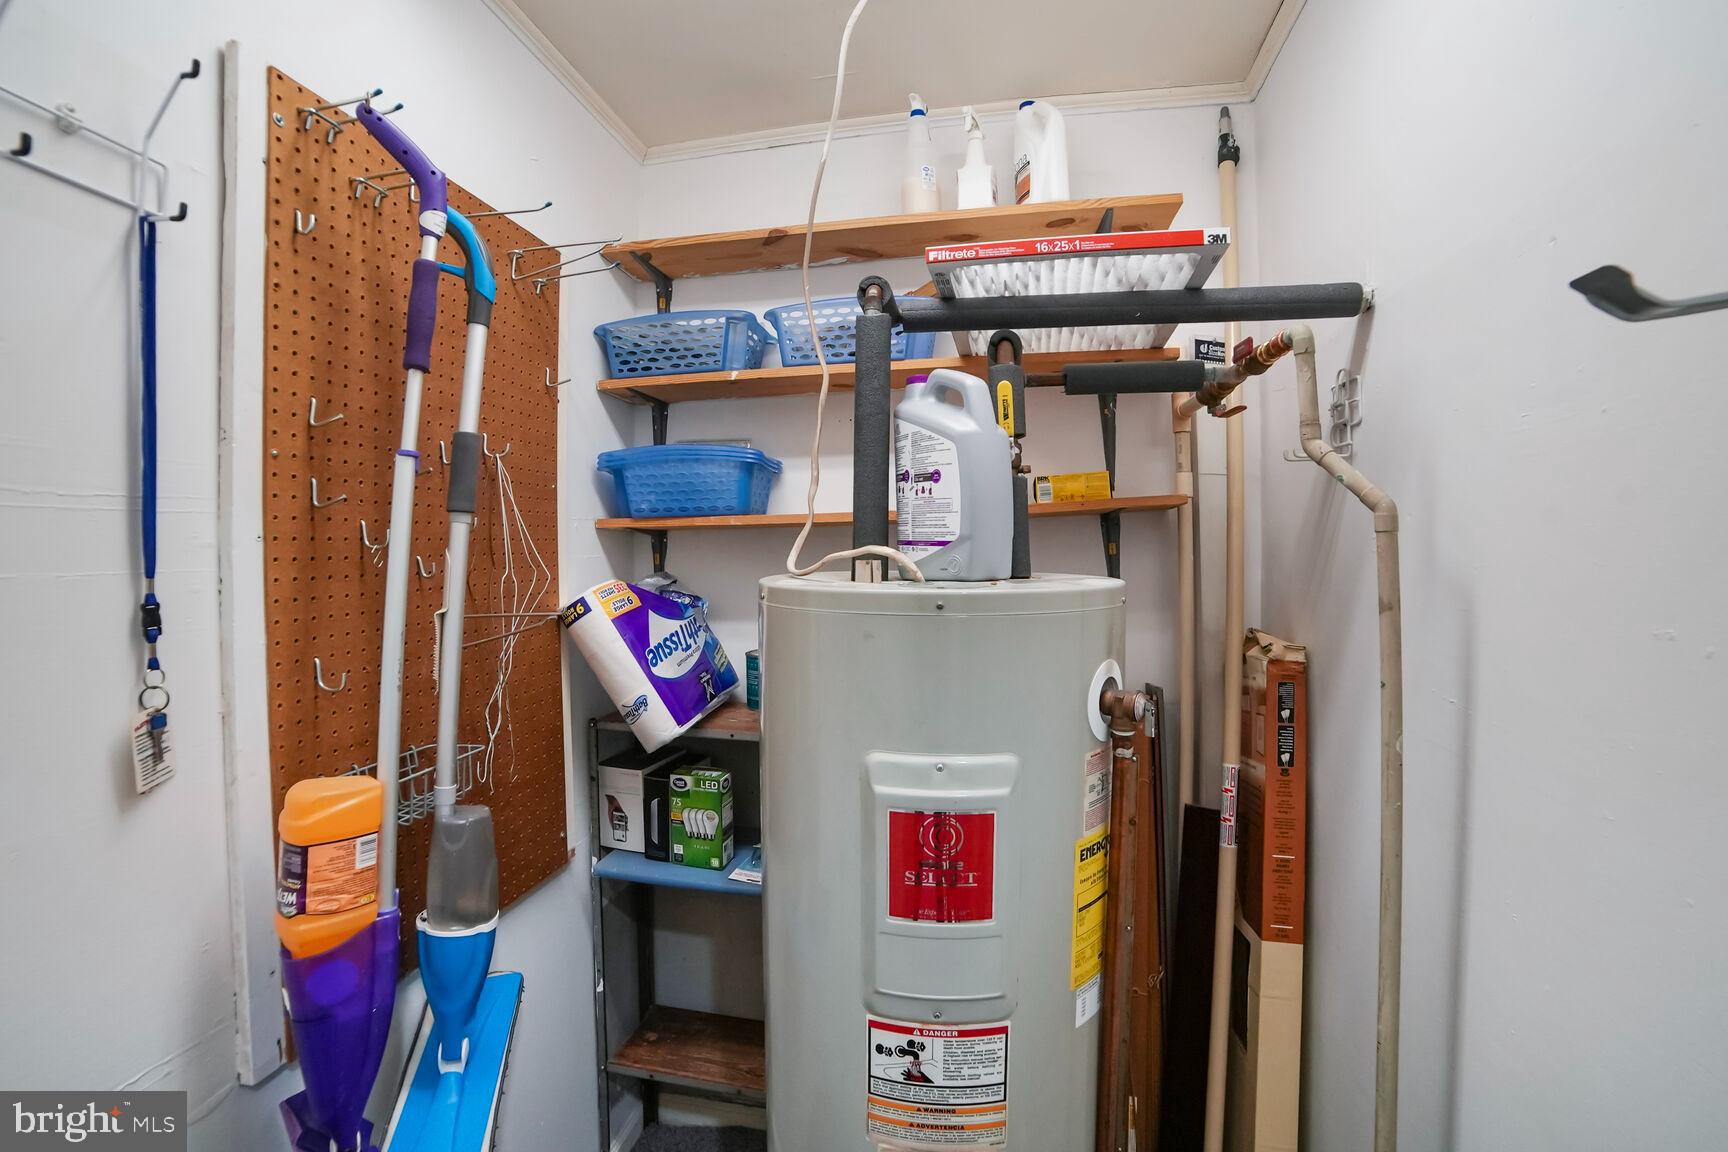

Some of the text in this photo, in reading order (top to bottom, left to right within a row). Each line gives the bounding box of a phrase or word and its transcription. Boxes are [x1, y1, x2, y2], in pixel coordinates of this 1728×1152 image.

[928, 248, 976, 261] Filtrete
[1035, 240, 1081, 253] 16x25x1
[1207, 233, 1228, 245] 3M
[576, 602, 585, 614] 9
[613, 596, 634, 612] 9 LARGE
[700, 780, 718, 789] LED
[671, 797, 682, 806] 75
[904, 870, 977, 884] SELT
[916, 1122, 965, 1130] ADVERTENCIA
